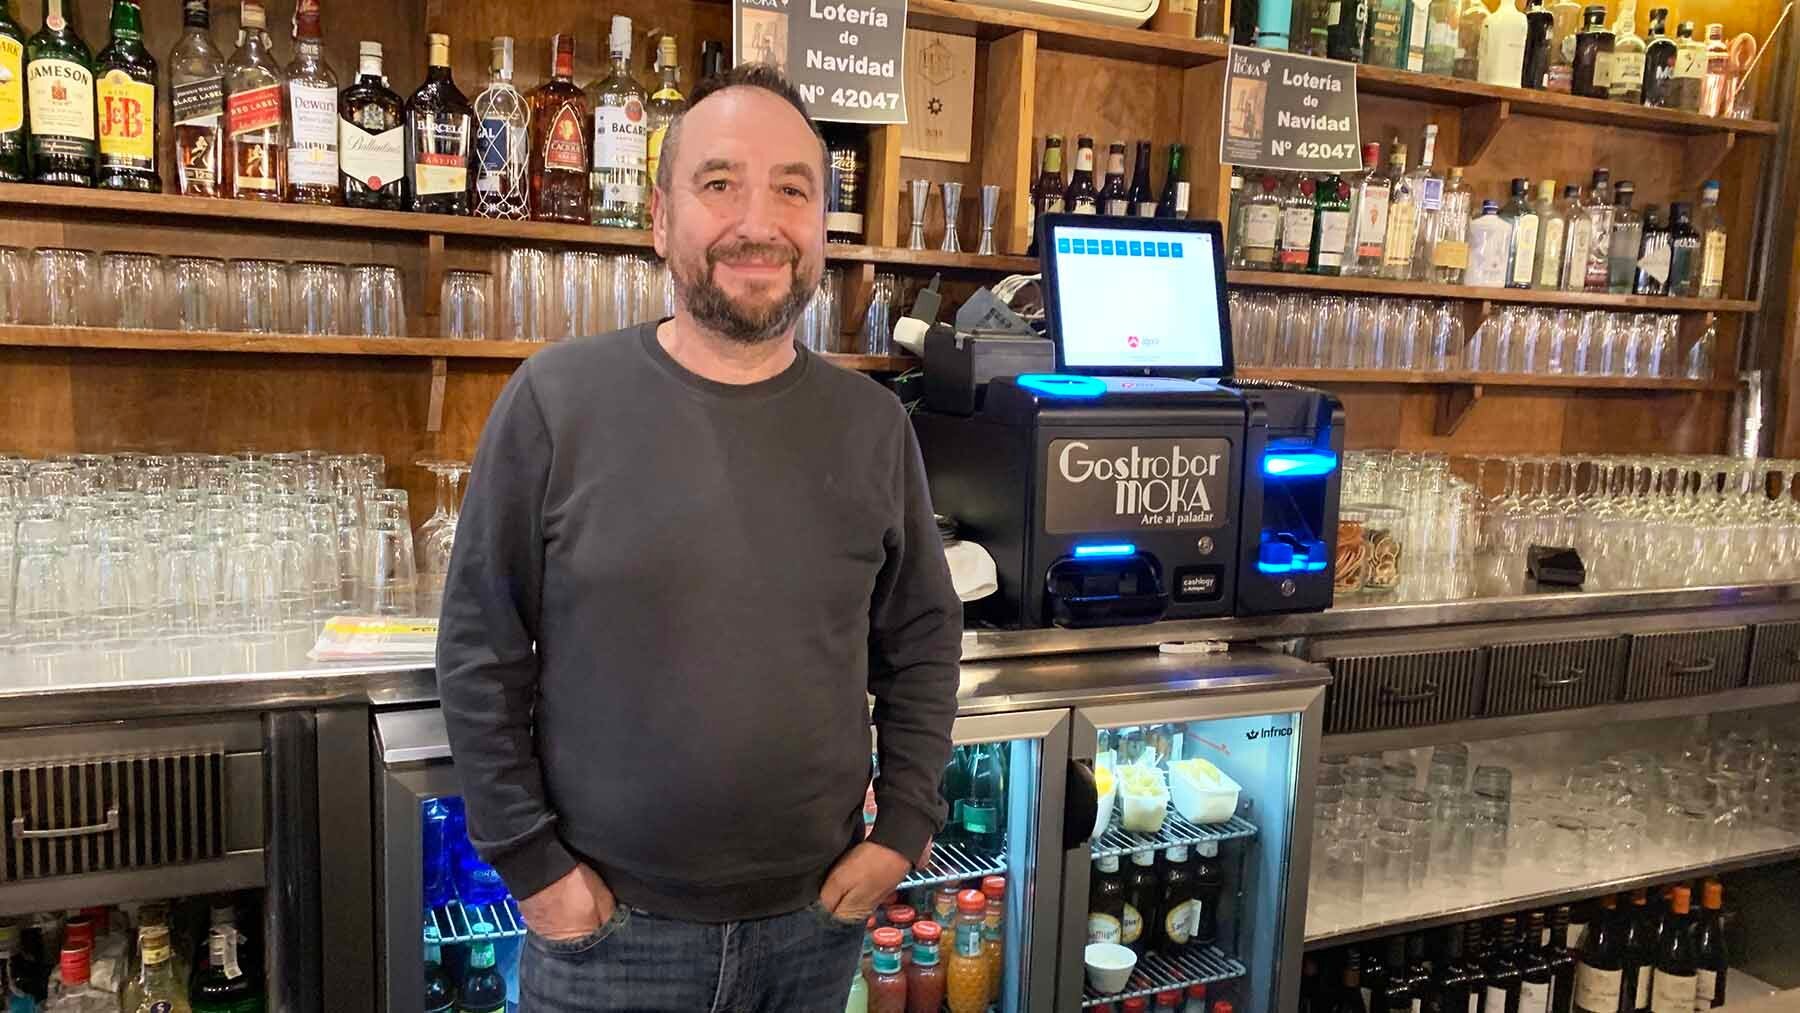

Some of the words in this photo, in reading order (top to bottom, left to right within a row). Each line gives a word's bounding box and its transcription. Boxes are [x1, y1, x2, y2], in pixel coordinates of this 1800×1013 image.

[809, 0, 888, 28] Lotería
[839, 31, 859, 46] de
[806, 49, 895, 78] Navidad
[30, 64, 88, 86] JAMESON
[1282, 68, 1342, 92] Lotería
[173, 96, 198, 106] BLACK
[199, 90, 224, 101] LABEL
[231, 104, 249, 116] RED
[250, 98, 279, 111] LABEL
[799, 84, 825, 104] Nº
[831, 87, 899, 110] 42047
[1303, 94, 1319, 108] de
[1278, 110, 1351, 131] Navidad
[1271, 140, 1292, 156] Nº
[1296, 142, 1356, 159] 42047
[1115, 478, 1211, 514] MOKA
[1140, 513, 1163, 525] Arte
[1166, 512, 1175, 524] al
[1177, 511, 1215, 526] paladar
[1261, 726, 1293, 738] Infrico
